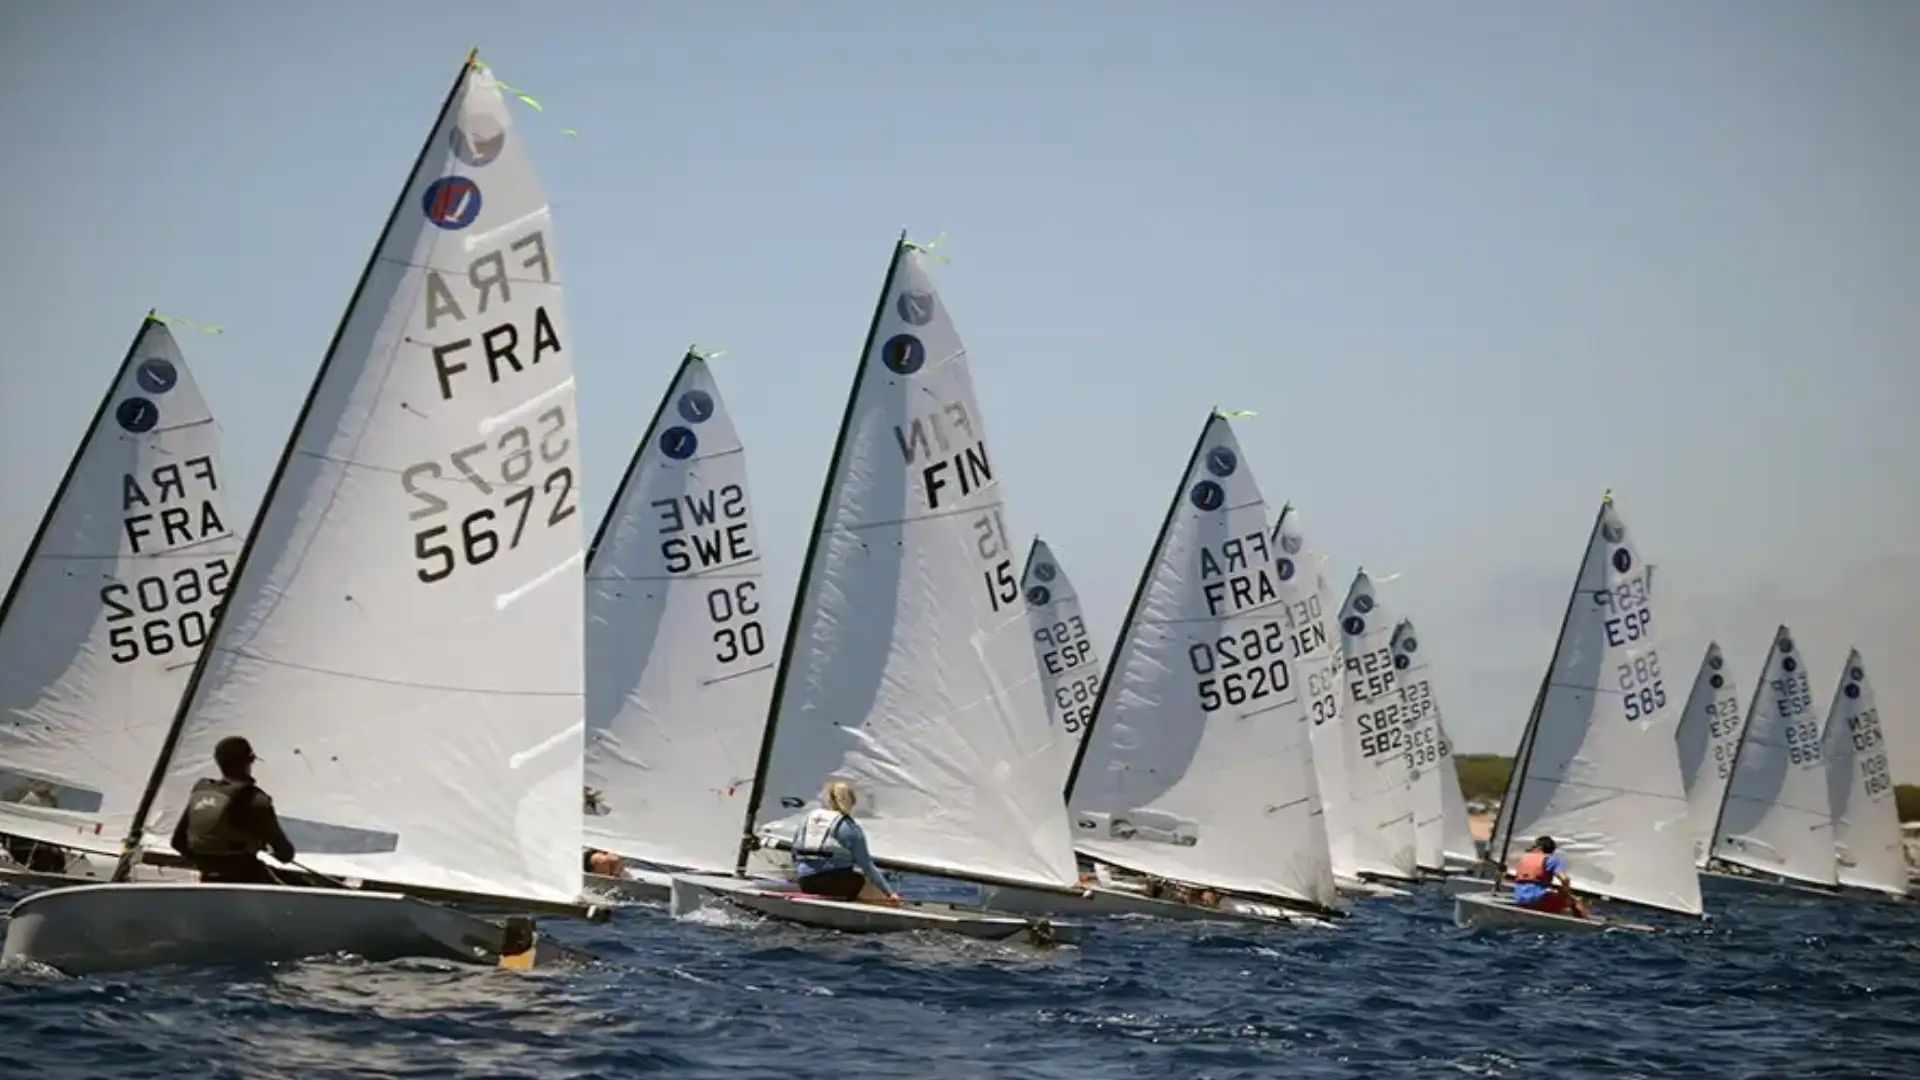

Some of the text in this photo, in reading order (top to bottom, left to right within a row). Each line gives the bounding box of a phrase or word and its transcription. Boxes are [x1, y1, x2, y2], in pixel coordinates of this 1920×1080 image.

[432, 306, 562, 400] FRA
[923, 441, 992, 509] FIN
[125, 500, 225, 553] FRA
[415, 467, 576, 583] 5672
[661, 523, 753, 575] SWE
[985, 560, 1018, 612] 15
[1204, 570, 1277, 616] FRA
[713, 621, 764, 664] 30
[1604, 609, 1651, 647] ESP
[1043, 639, 1091, 674] ESP
[1198, 660, 1290, 713] 5620
[1351, 671, 1395, 702] ESP
[1623, 681, 1667, 722] 585
[1063, 706, 1093, 733] 56
[1312, 694, 1337, 726] 33
[1361, 728, 1402, 758] 582
